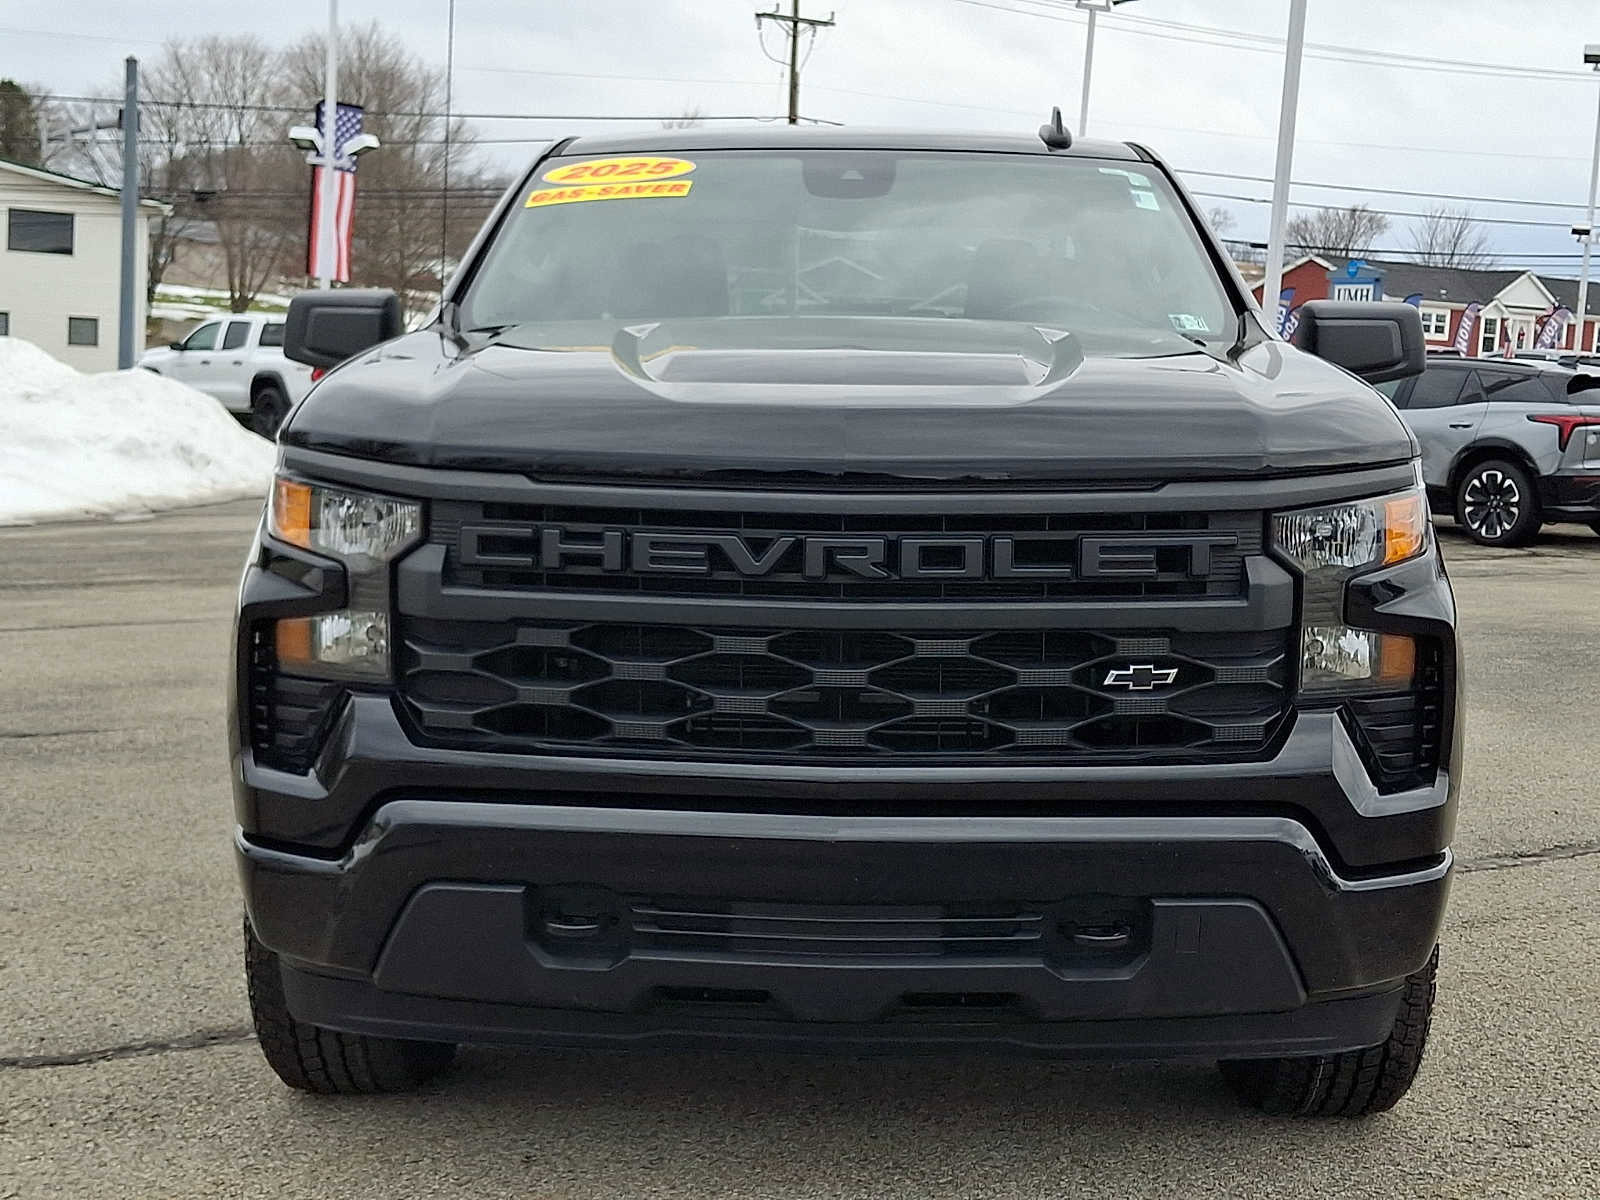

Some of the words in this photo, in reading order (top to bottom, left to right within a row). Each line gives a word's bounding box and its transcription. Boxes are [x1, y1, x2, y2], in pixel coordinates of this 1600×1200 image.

[560, 161, 681, 181] 2025
[531, 184, 689, 203] GAS-SAVER
[1337, 287, 1371, 301] UMH
[1543, 318, 1558, 344] FOR
[460, 524, 1238, 579] CHEVROLET
